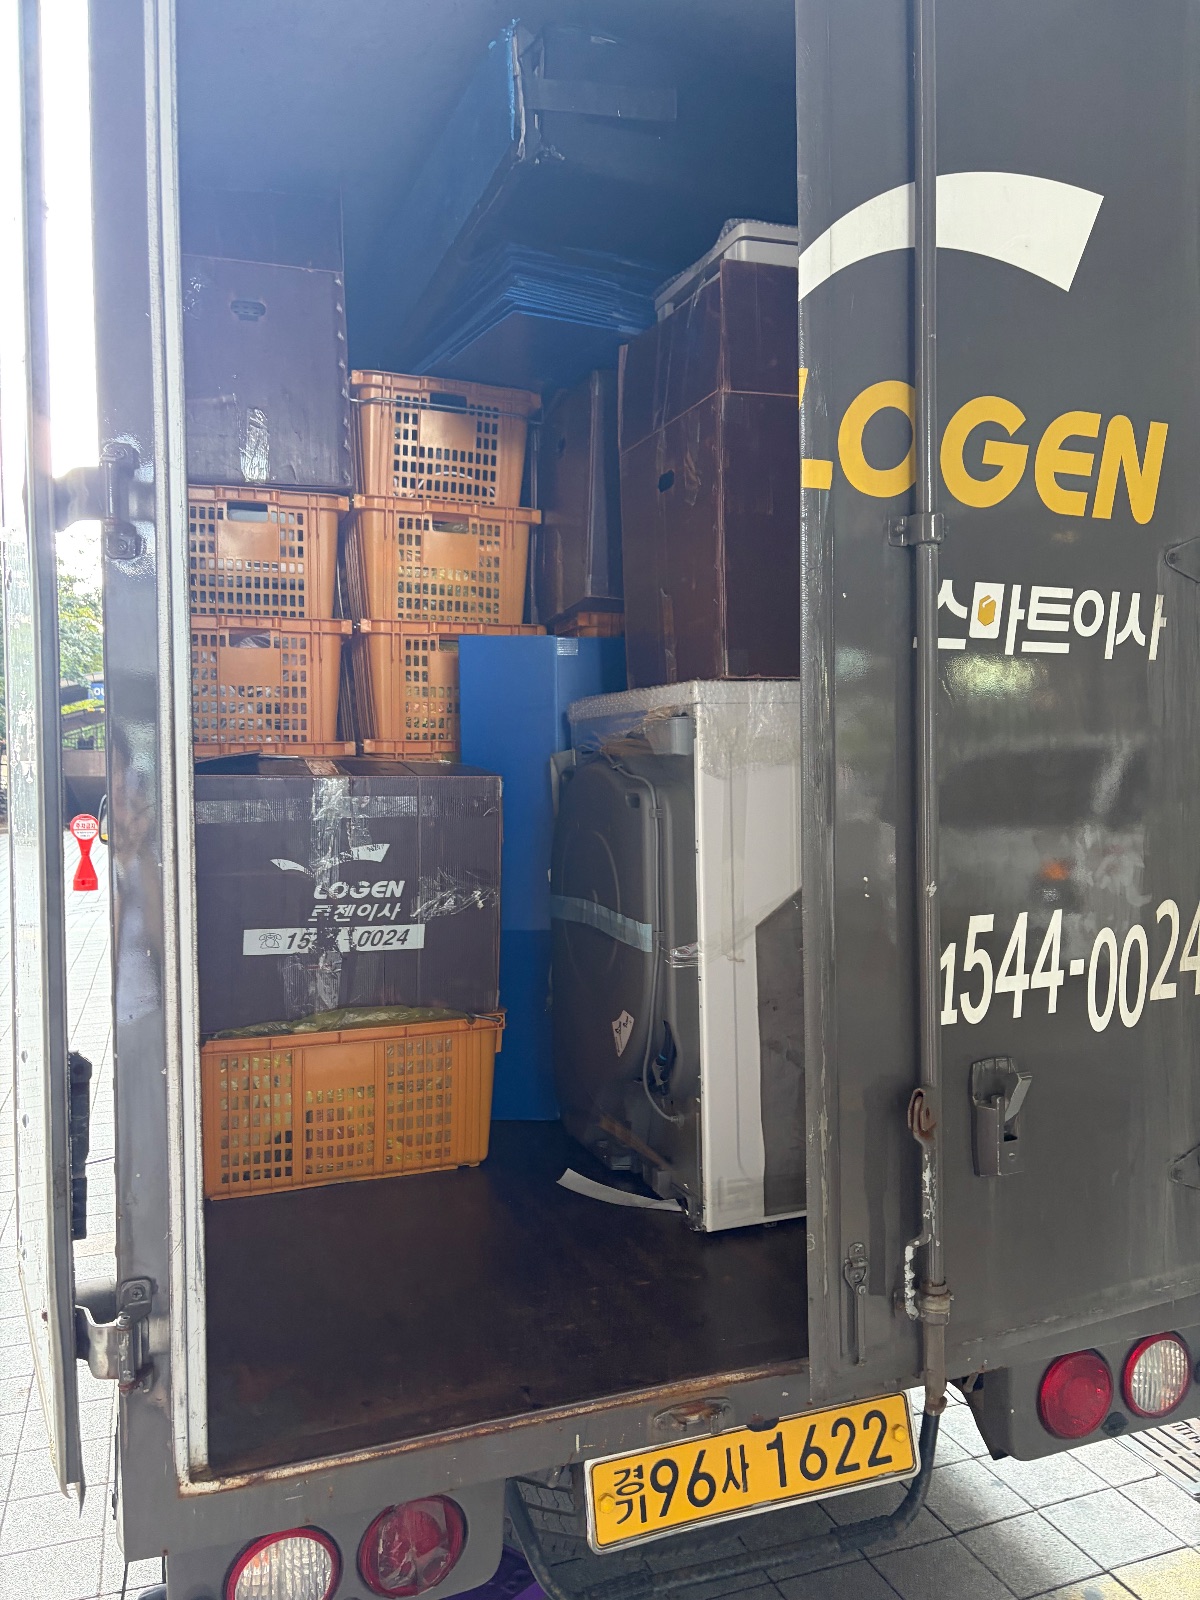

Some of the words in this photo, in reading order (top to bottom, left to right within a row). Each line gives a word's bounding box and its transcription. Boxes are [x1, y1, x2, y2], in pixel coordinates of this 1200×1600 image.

[286, 928, 411, 950] 15-0024
[649, 1444, 750, 1518] 96사
[766, 1409, 893, 1488] 1622
